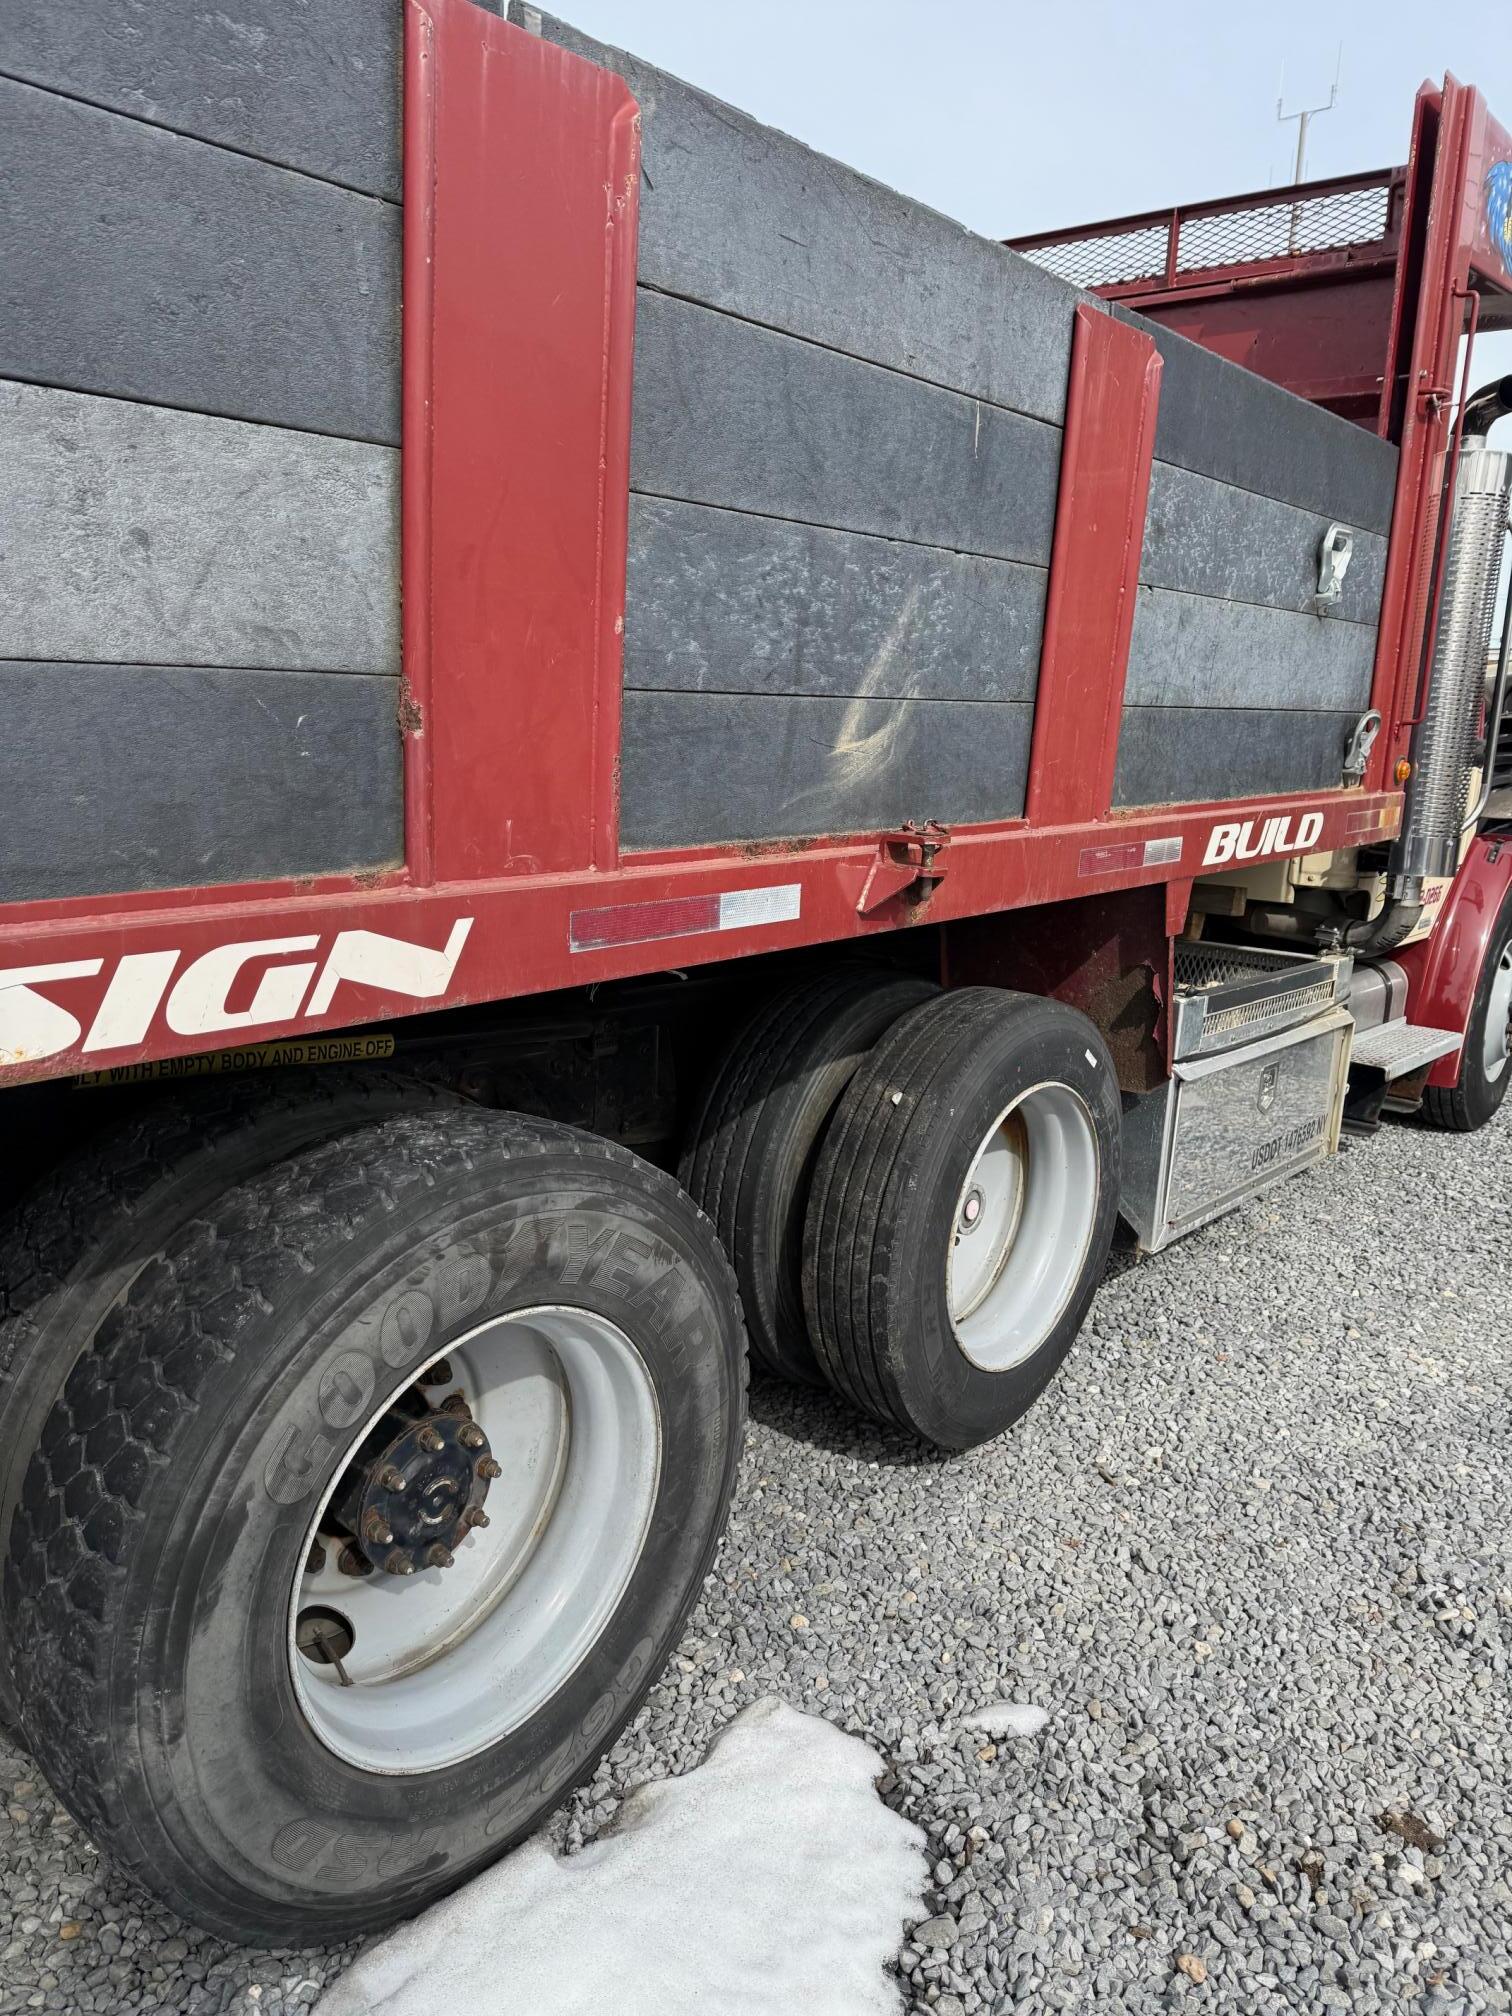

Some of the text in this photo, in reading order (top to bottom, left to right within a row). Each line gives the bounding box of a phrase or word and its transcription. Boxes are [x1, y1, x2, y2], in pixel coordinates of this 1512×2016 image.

[1202, 812, 1324, 867] BUILD
[111, 1063, 153, 1081] WITH
[159, 1055, 216, 1077] EMPTY
[221, 1051, 267, 1070] BODY
[271, 1047, 303, 1065] AND
[308, 1042, 361, 1062] ENGINE
[366, 1039, 393, 1056] OFF
[1252, 1136, 1283, 1170] USDOT
